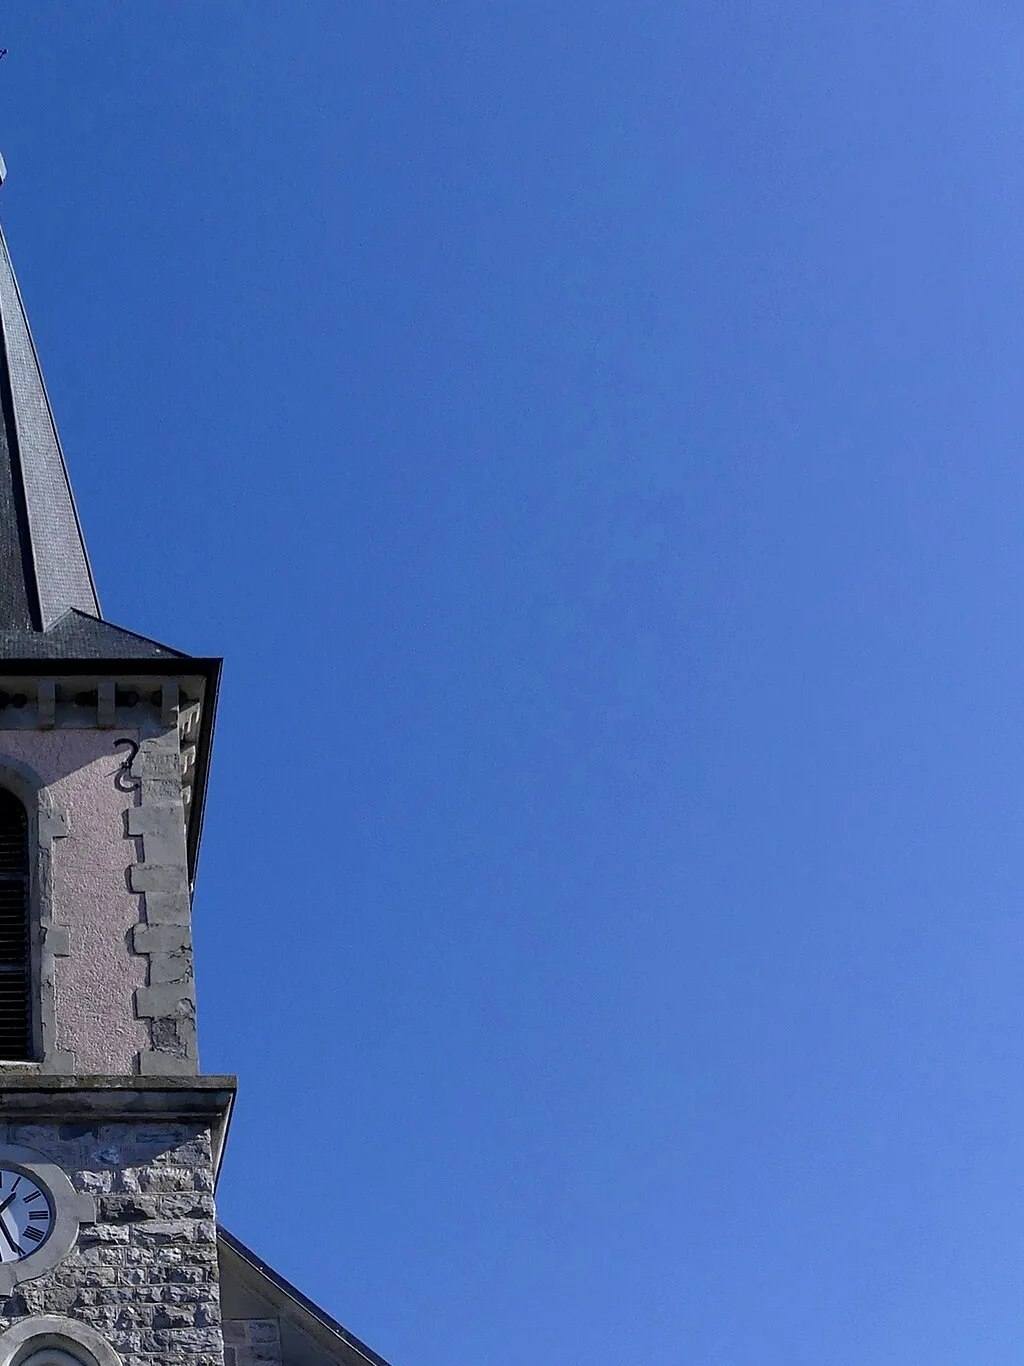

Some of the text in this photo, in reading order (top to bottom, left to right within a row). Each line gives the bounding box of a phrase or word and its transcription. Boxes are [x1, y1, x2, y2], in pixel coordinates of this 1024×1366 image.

[11, 1176, 22, 1192] I
[23, 1190, 42, 1204] II
[29, 1210, 49, 1220] III
[22, 1225, 45, 1243] IIII
